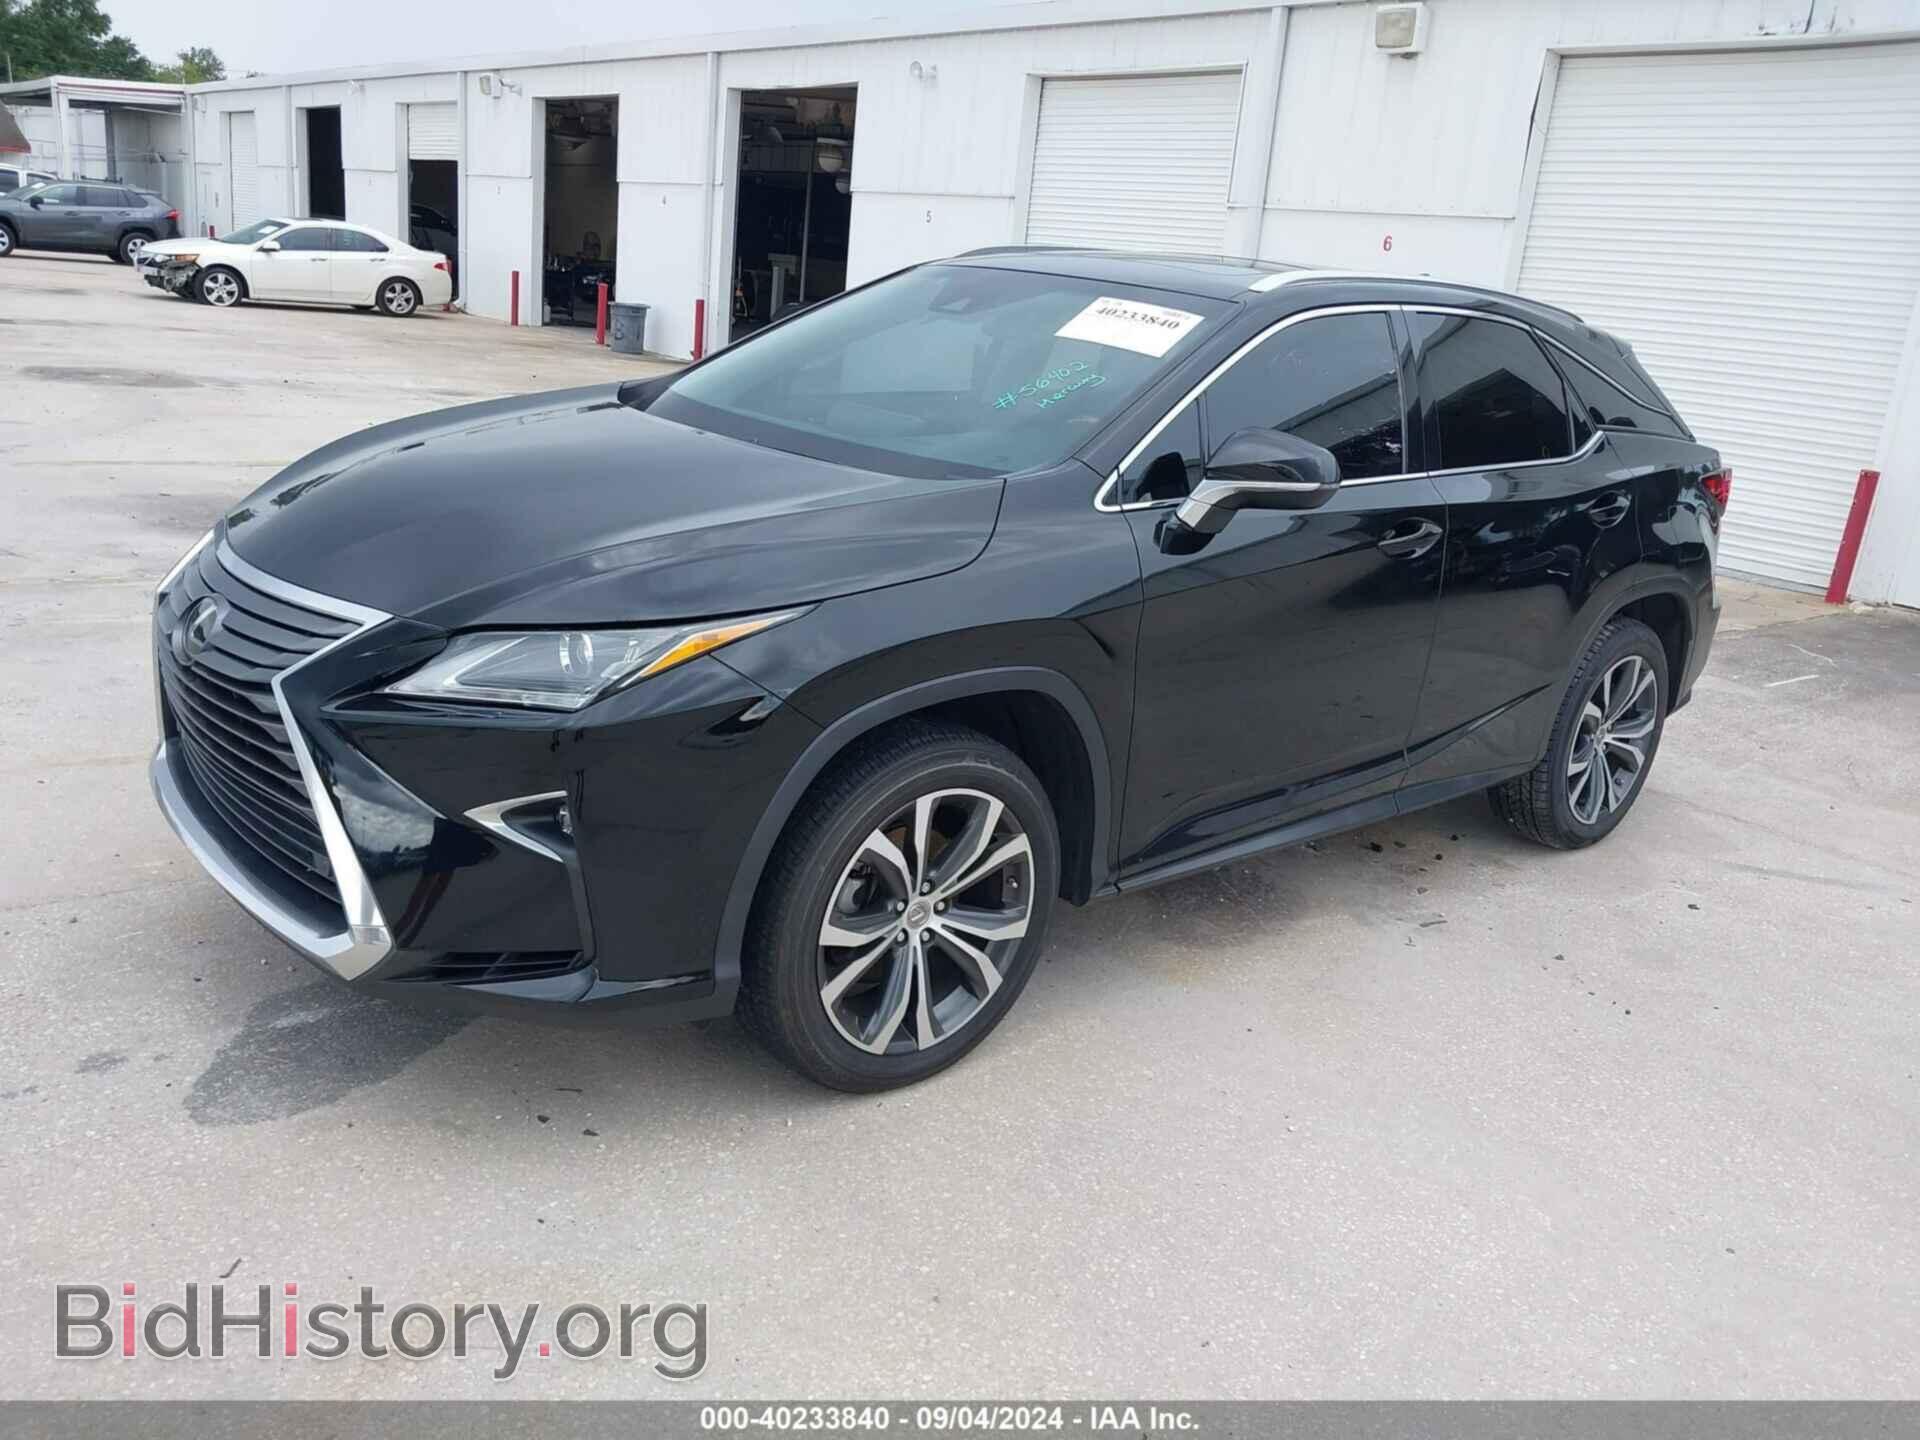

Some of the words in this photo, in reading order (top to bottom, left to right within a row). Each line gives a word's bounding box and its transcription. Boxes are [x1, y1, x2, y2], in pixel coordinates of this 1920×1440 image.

[925, 209, 933, 224] 5
[1382, 234, 1393, 252] 6
[1096, 306, 1180, 330] 40233840
